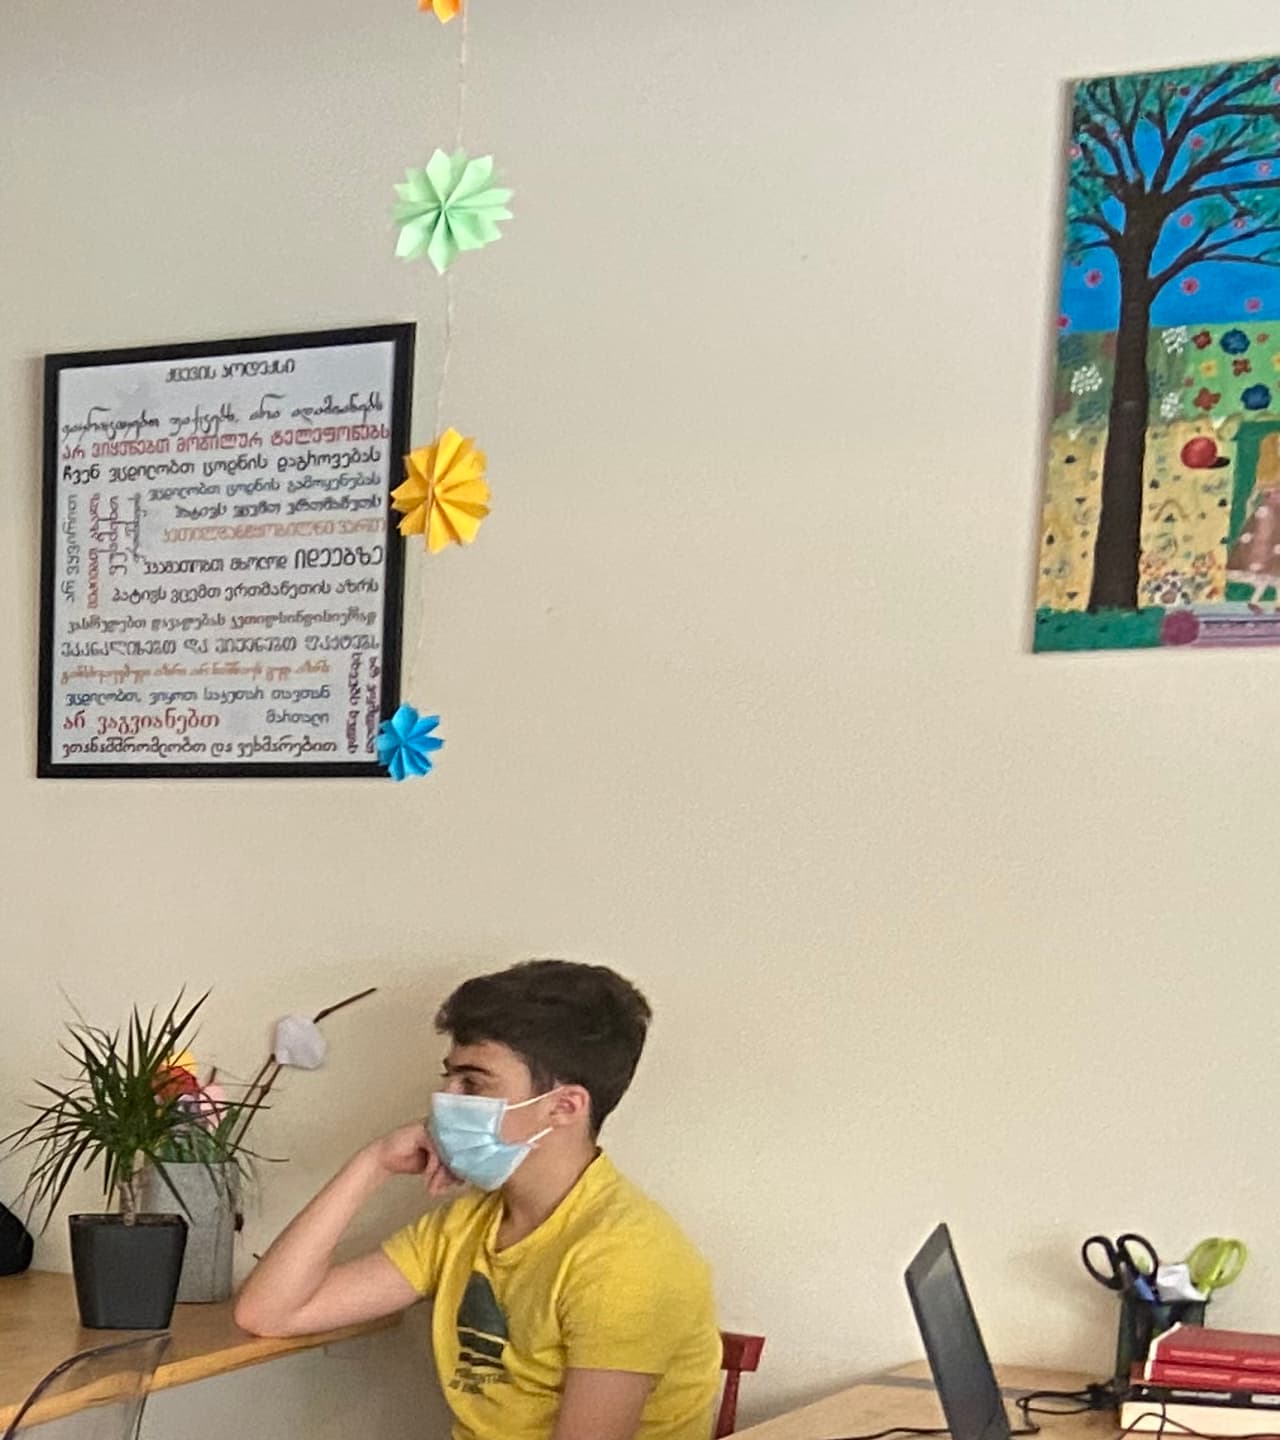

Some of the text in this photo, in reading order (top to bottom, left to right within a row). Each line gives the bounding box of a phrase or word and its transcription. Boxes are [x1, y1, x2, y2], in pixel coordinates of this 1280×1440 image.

[62, 444, 86, 460] არ
[62, 446, 381, 484] ჩვენ ვცდილობთ ცოდნის დაგროვებას
[294, 545, 384, 569] იდეებზე
[112, 577, 379, 605] პატივს ვცემთ ერთმანეთის აზრს
[63, 707, 220, 735] არ ვაგვიანებთ
[62, 734, 337, 758] ვთანამშრომლობთ და ვეხმარებით
